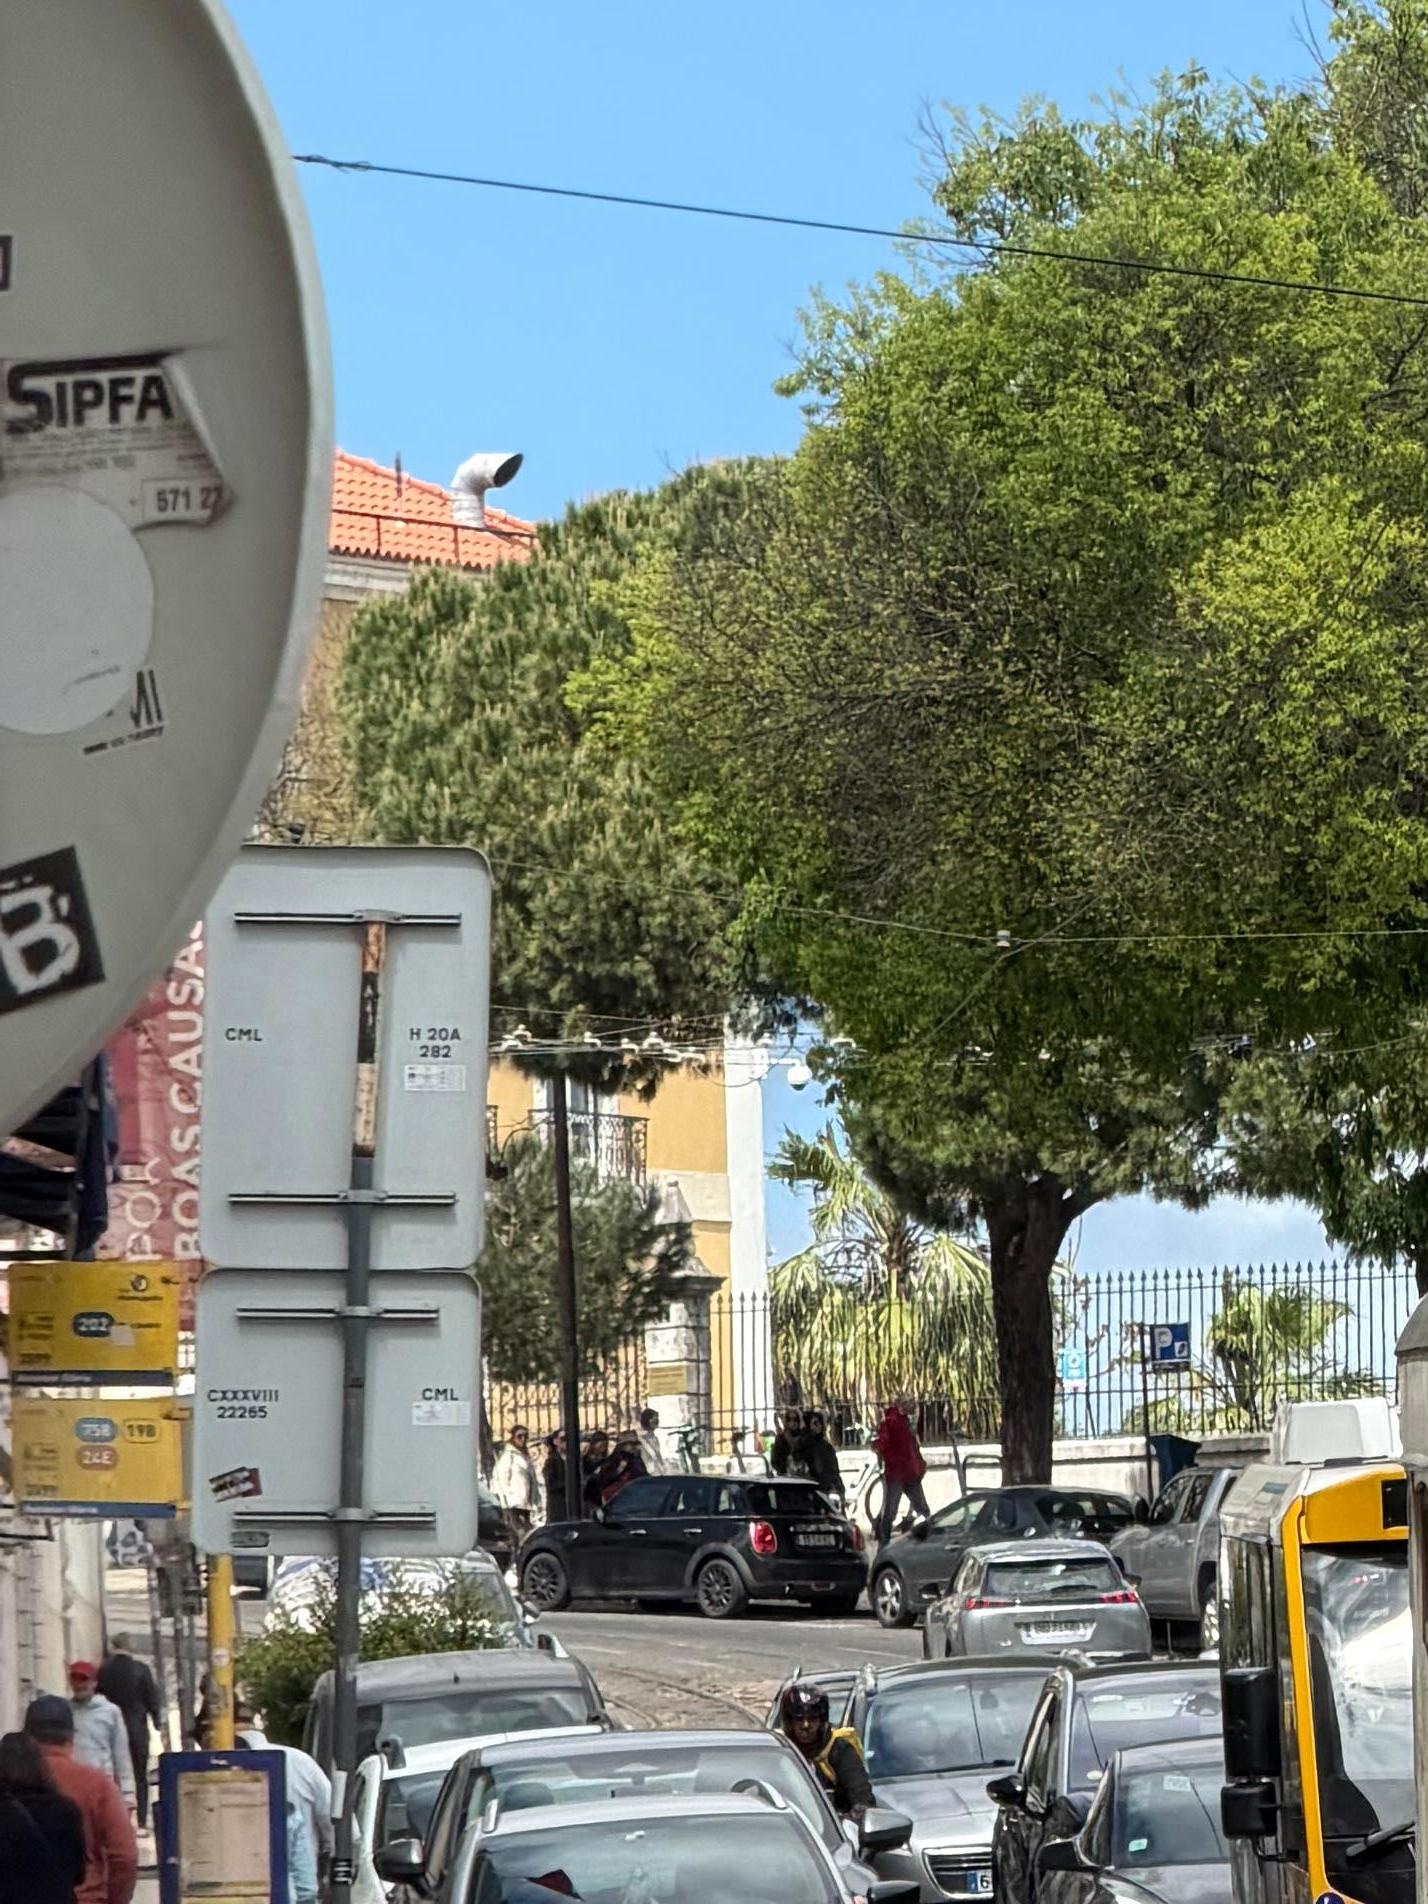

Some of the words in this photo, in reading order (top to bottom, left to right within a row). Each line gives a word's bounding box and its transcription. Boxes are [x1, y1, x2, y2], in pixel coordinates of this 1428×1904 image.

[7, 350, 178, 435] SIPFA
[225, 1027, 263, 1042] CML
[409, 1027, 421, 1041] H
[427, 1026, 462, 1042] 20A
[419, 1044, 452, 1059] 282
[421, 1387, 460, 1402] CML
